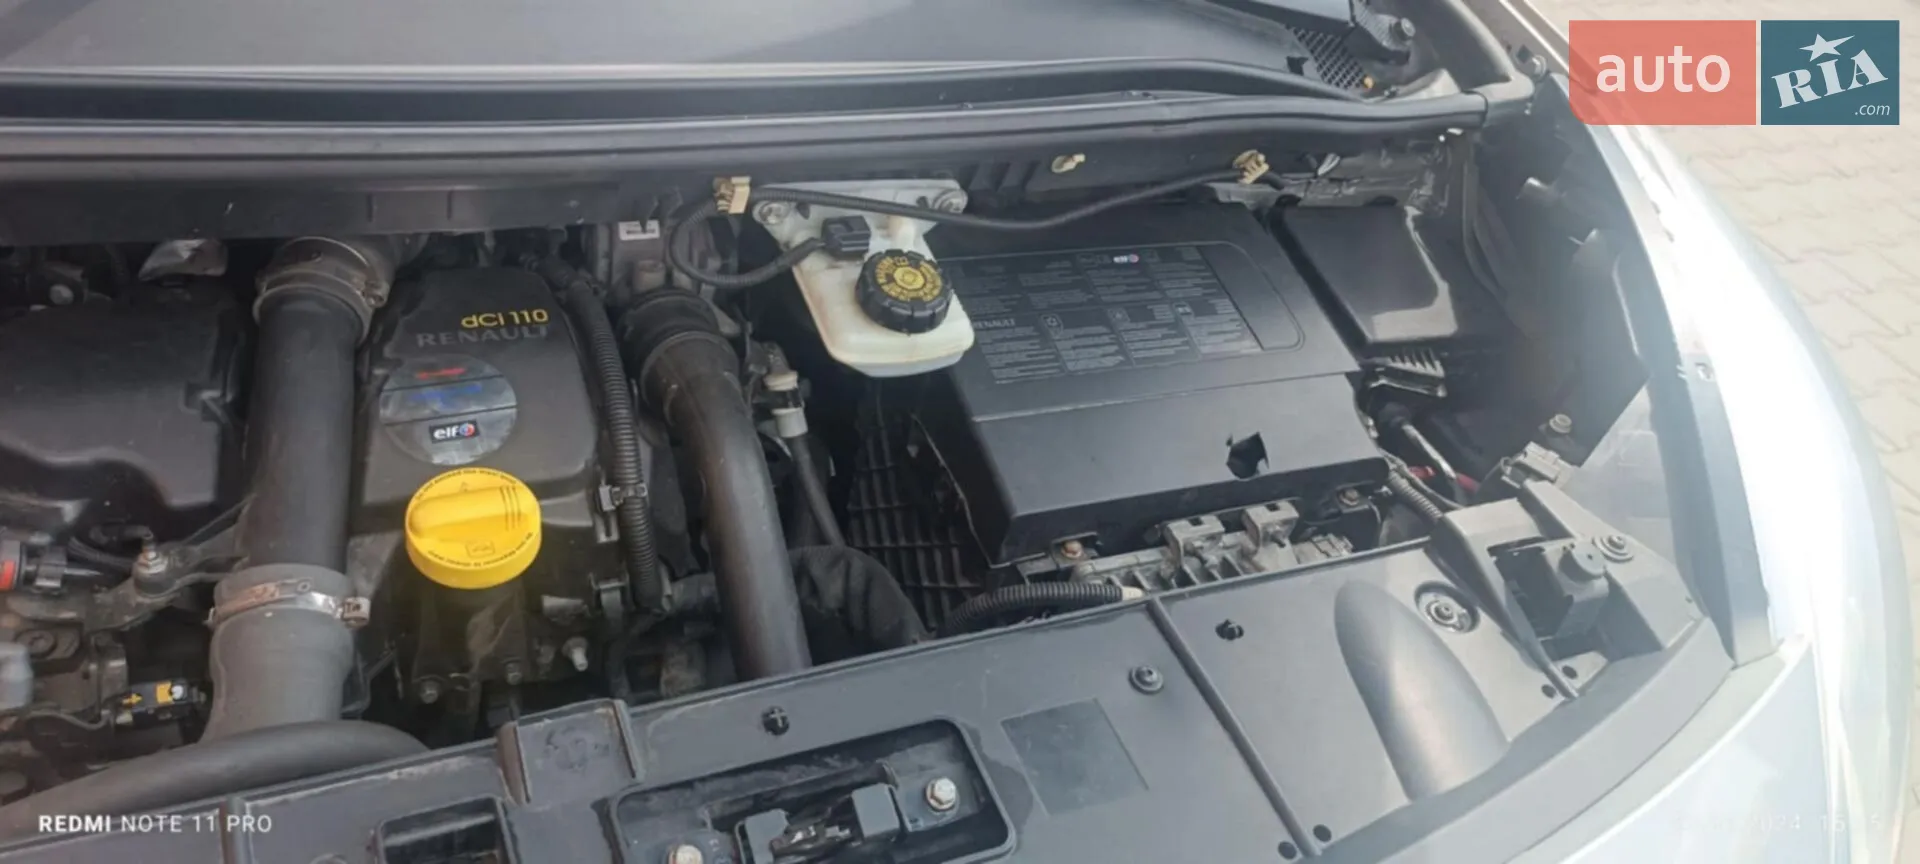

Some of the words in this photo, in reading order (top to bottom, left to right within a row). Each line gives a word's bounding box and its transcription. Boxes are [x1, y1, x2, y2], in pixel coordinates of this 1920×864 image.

[509, 309, 549, 325] 110
[415, 326, 549, 348] RENAULT
[433, 424, 460, 440] elf
